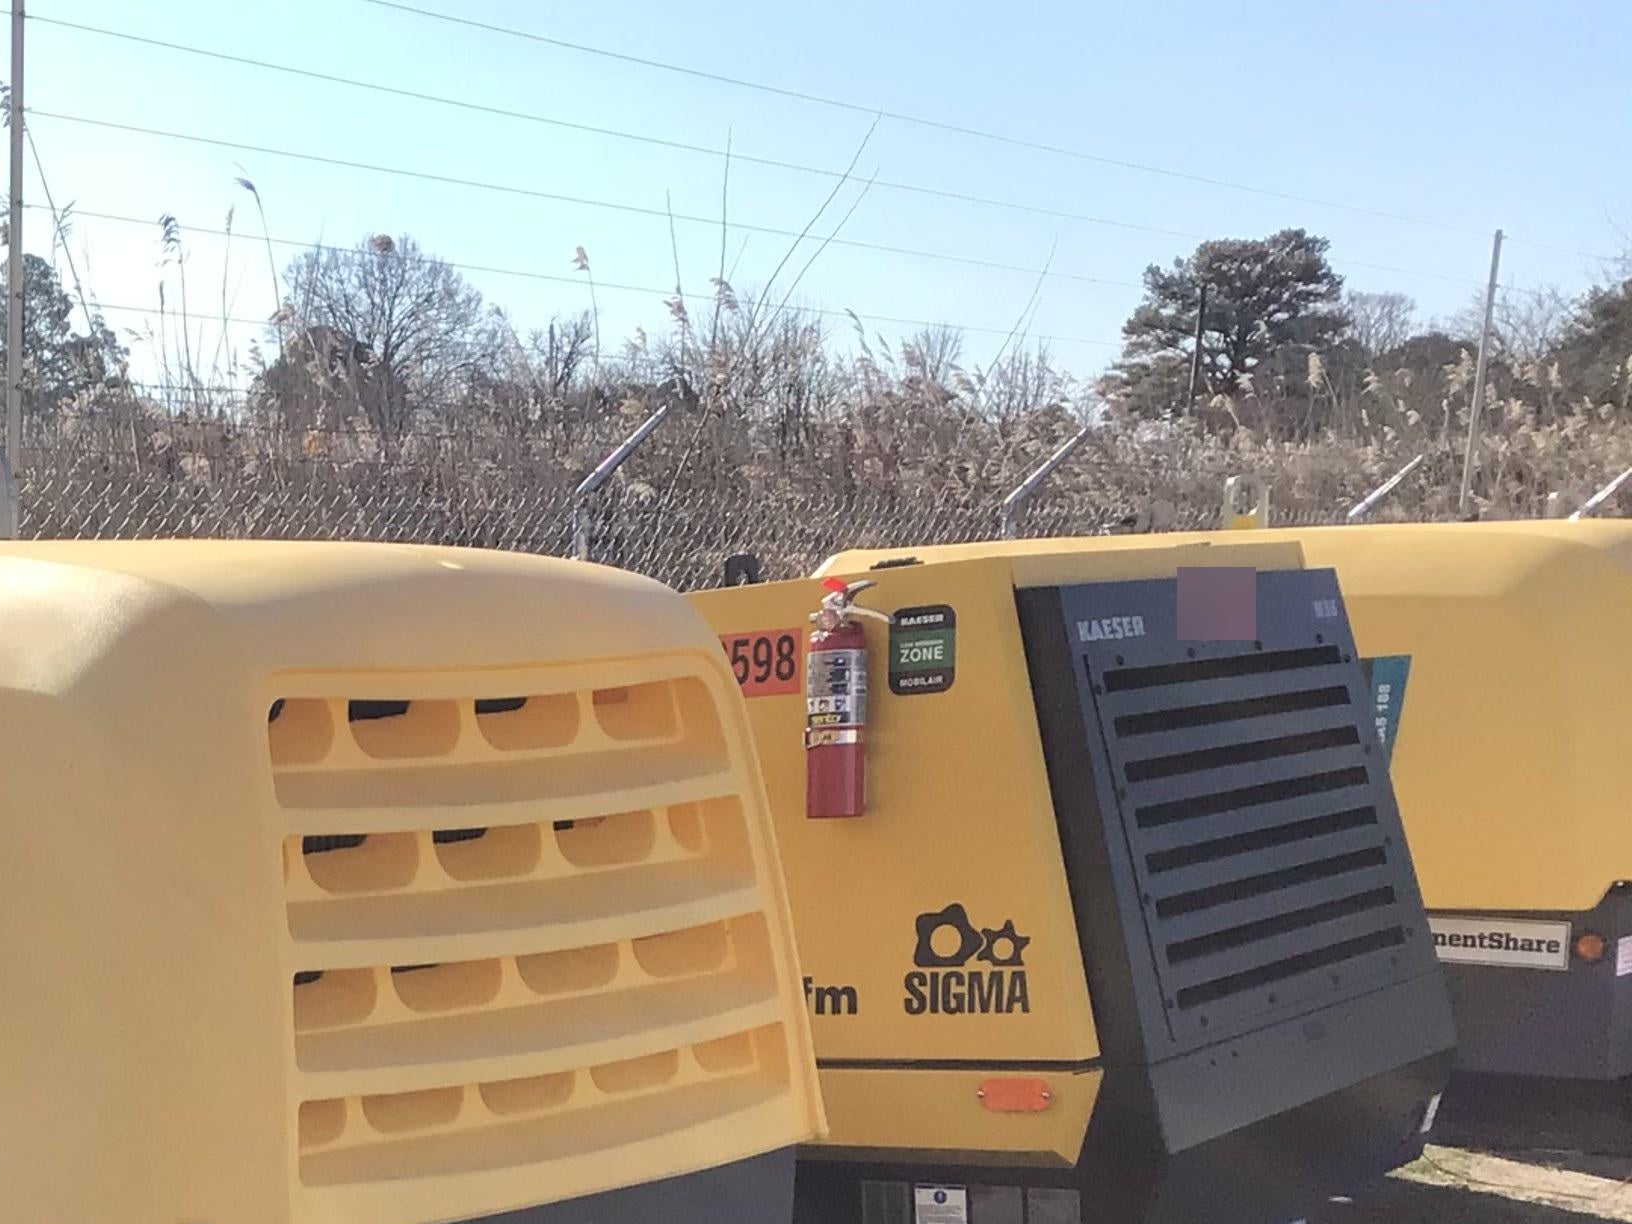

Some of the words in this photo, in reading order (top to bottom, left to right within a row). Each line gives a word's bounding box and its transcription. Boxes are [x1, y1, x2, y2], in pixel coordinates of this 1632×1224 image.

[900, 614, 944, 626] KAESER
[1076, 615, 1146, 642] KAESER
[722, 635, 795, 685] 598
[900, 645, 944, 663] ZONE
[1376, 684, 1391, 712] 188
[904, 971, 1030, 1014] SIGMA
